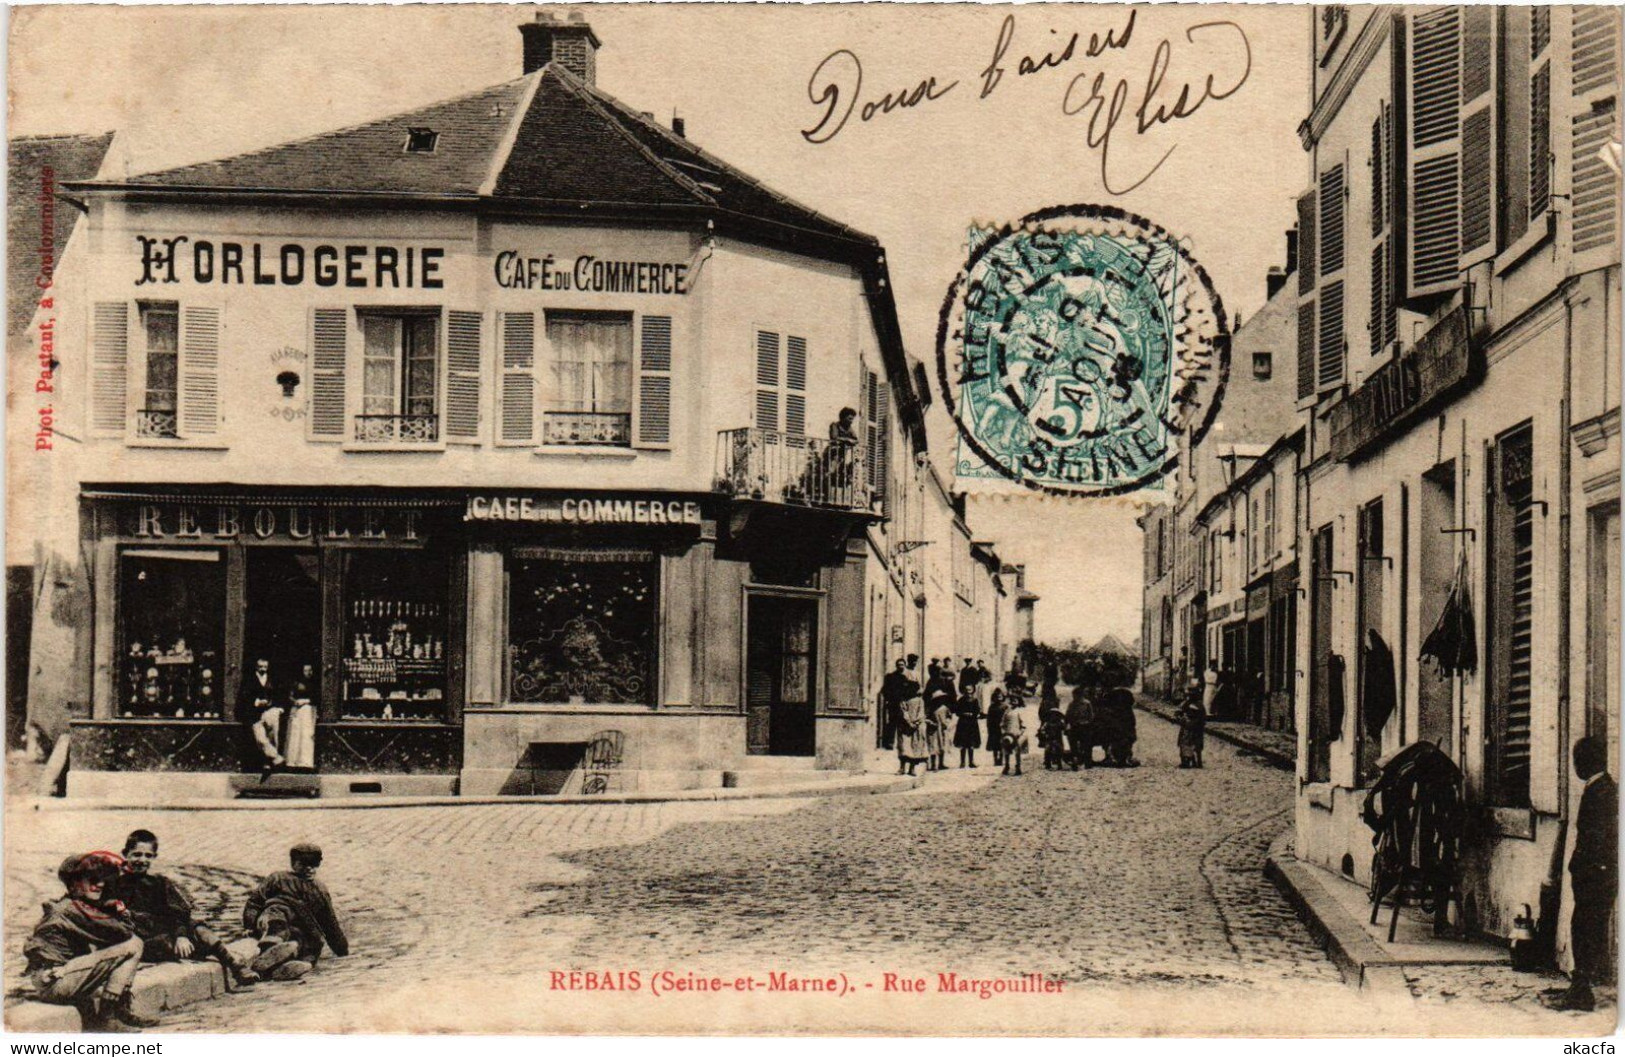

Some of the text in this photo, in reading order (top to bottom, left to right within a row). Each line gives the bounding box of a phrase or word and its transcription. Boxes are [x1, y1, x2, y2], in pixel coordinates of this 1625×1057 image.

[801, 9, 1136, 144] Doux baisers
[134, 235, 445, 289] HORLOGERIE
[494, 250, 689, 294] CAFÉ DU COMMERCE
[135, 505, 423, 540] REBOULET
[562, 498, 698, 524] COMMERCE
